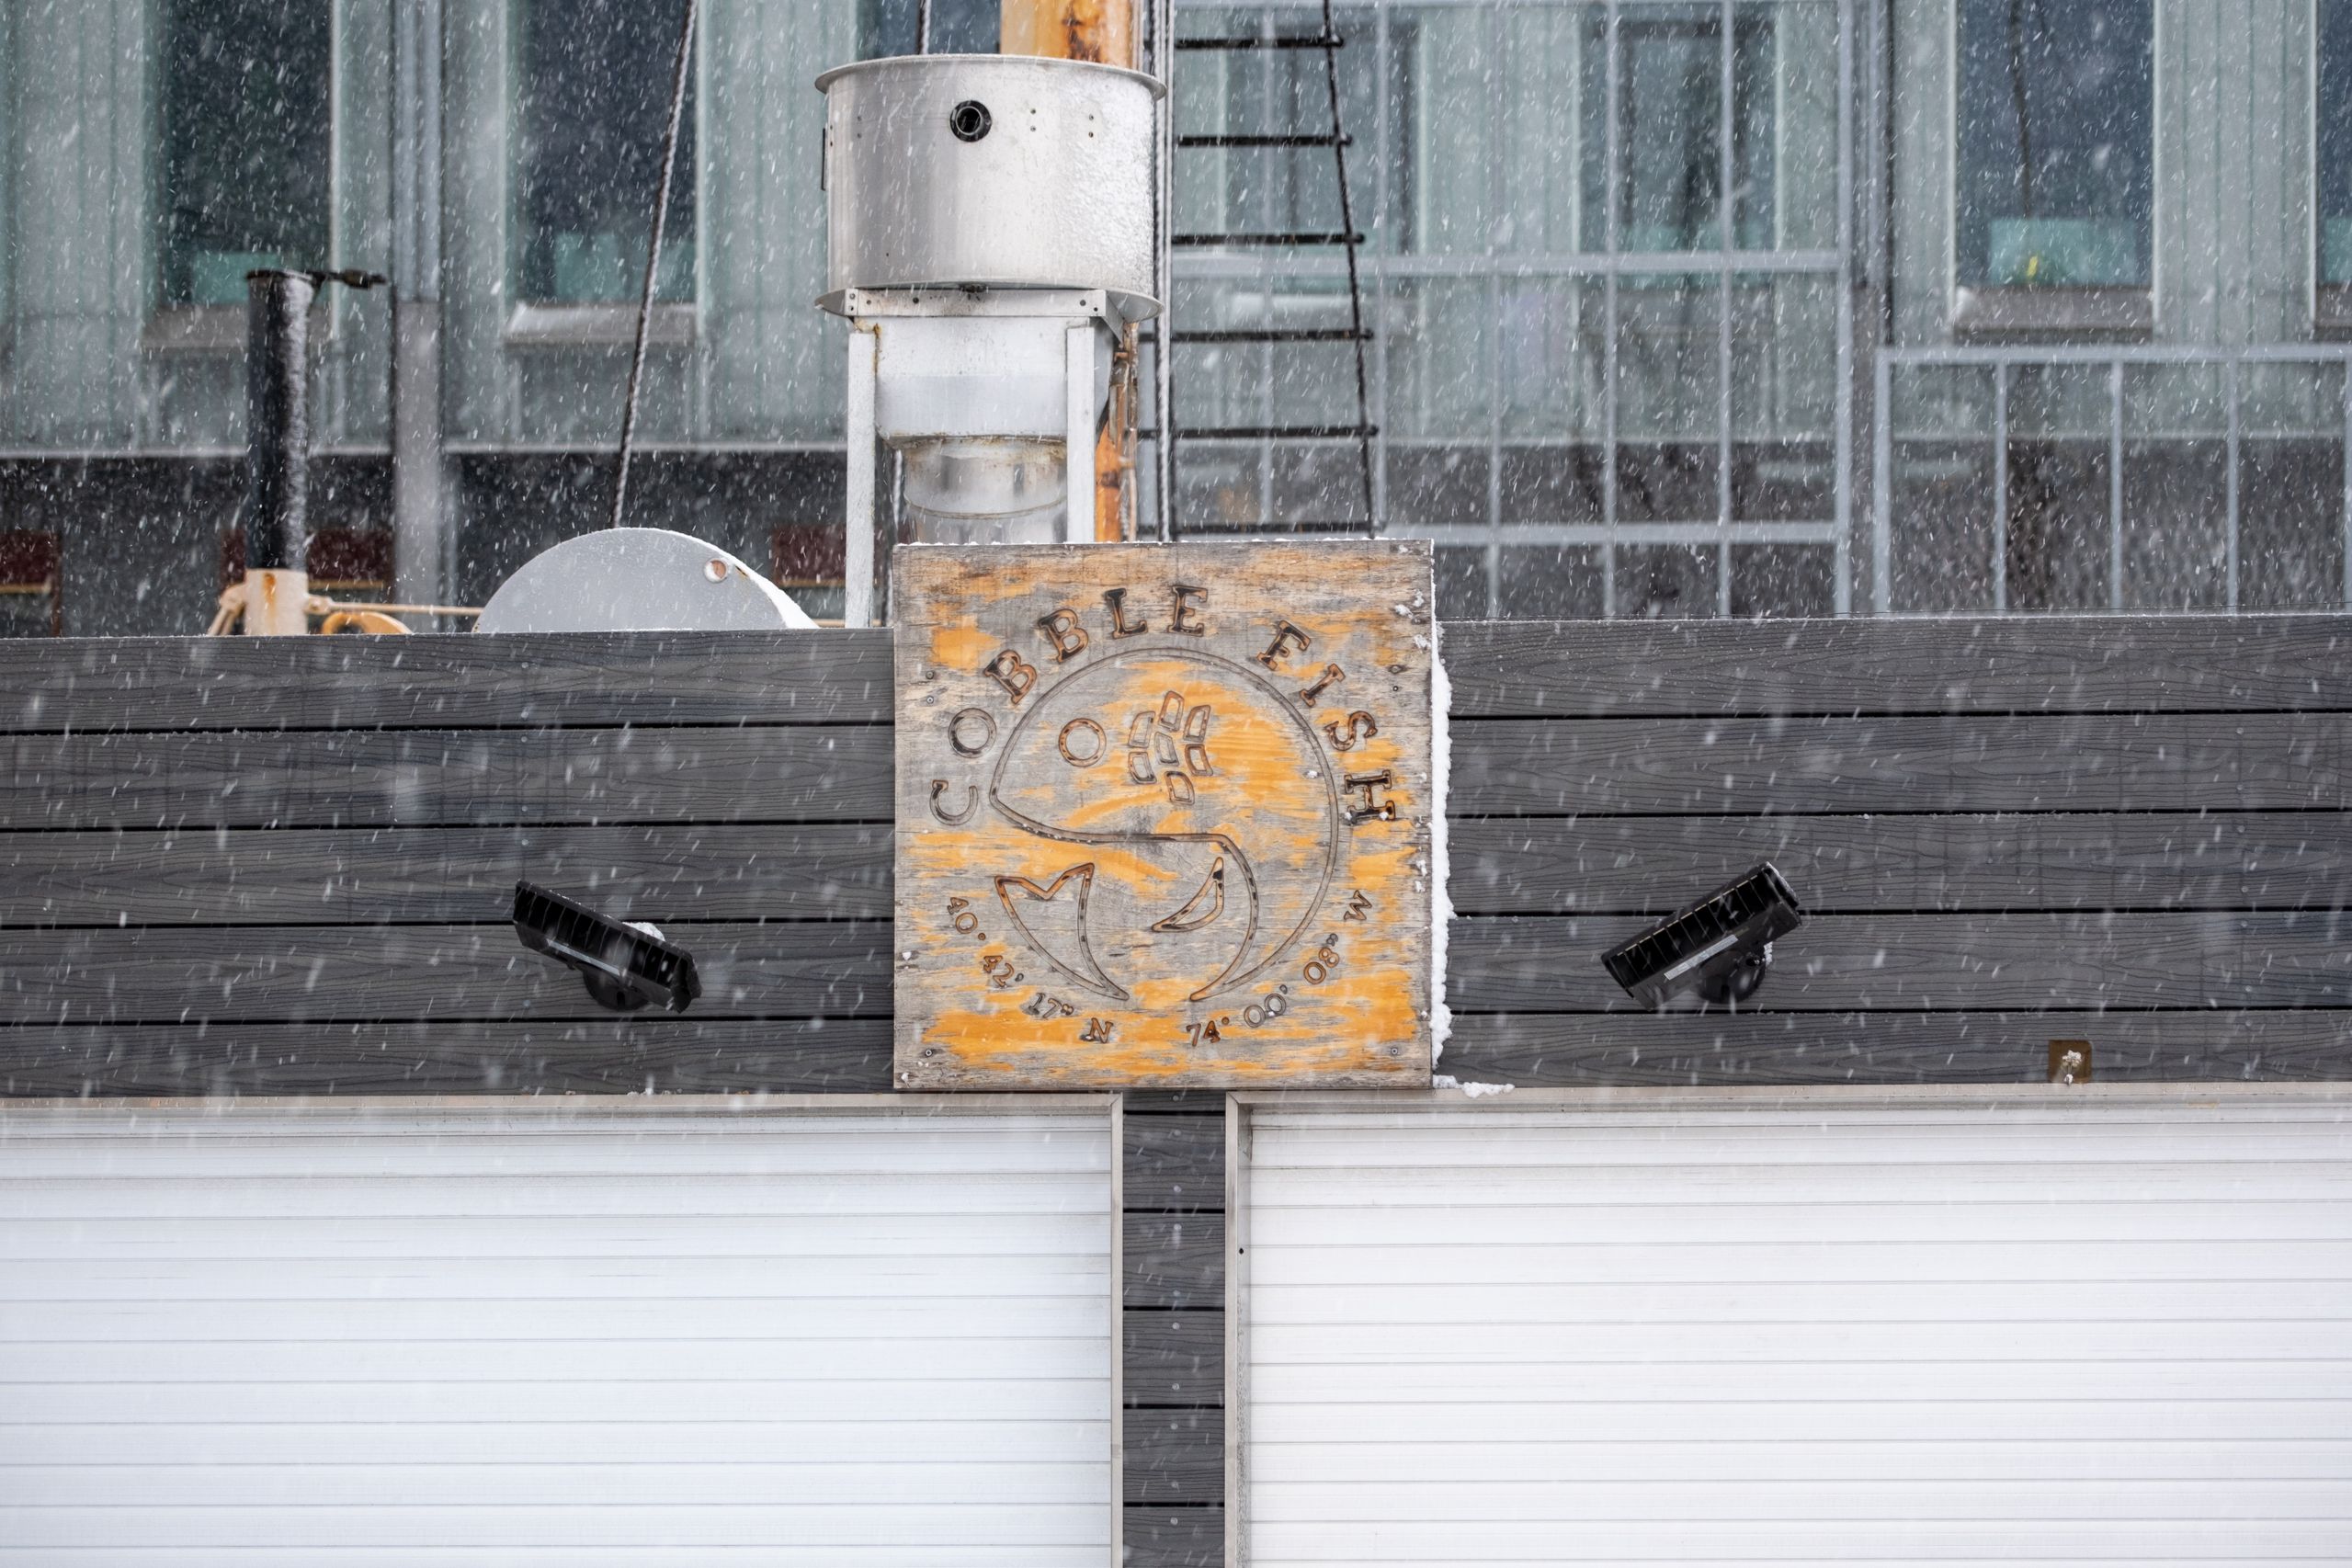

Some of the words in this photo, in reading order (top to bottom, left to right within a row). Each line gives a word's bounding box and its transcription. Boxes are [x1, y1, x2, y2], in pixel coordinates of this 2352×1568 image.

[929, 585, 1209, 825] COBBLE
[1256, 619, 1395, 821] FISH
[1082, 1017, 1114, 1044] N
[1343, 890, 1373, 922] W
